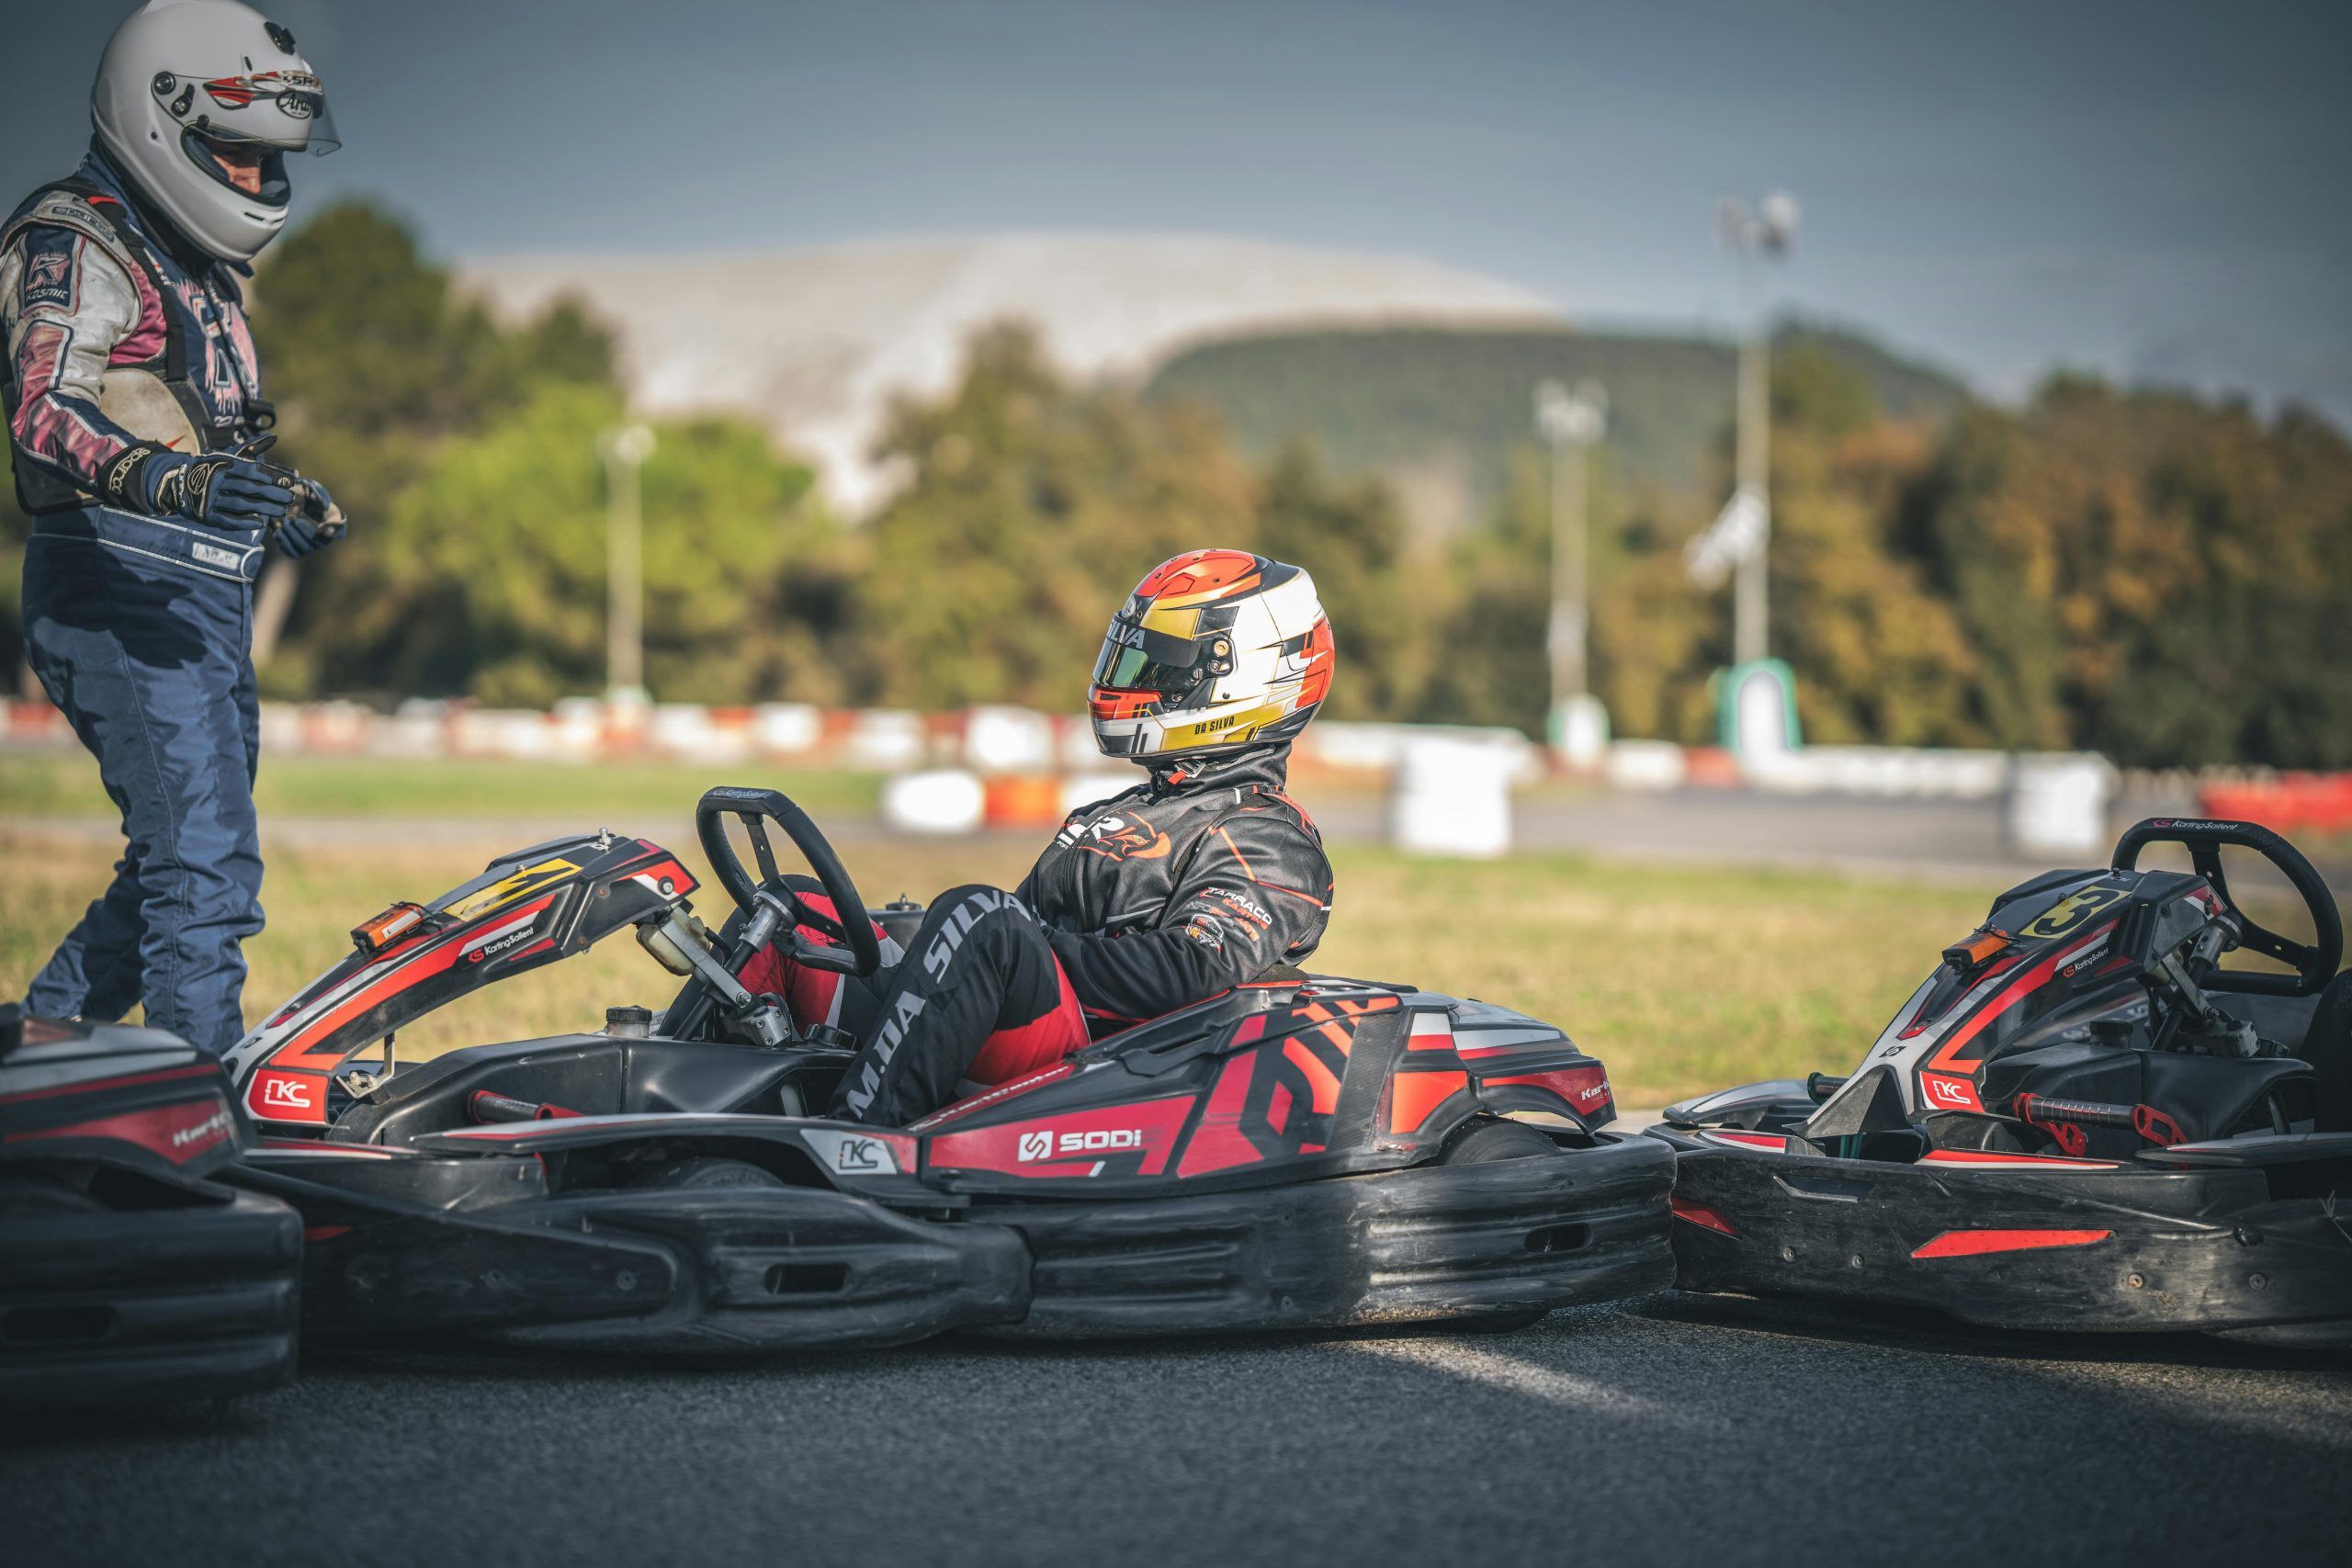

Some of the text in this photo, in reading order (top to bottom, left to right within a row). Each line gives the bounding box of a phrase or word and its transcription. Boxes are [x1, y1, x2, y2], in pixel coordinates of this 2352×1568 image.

[108, 446, 151, 495] sparco
[1194, 716, 1235, 735] DA SILVA
[1207, 886, 1272, 926] TARRACO
[2033, 889, 2120, 936] 3
[484, 926, 535, 956] KartingSallent
[923, 889, 1032, 984] SILVA
